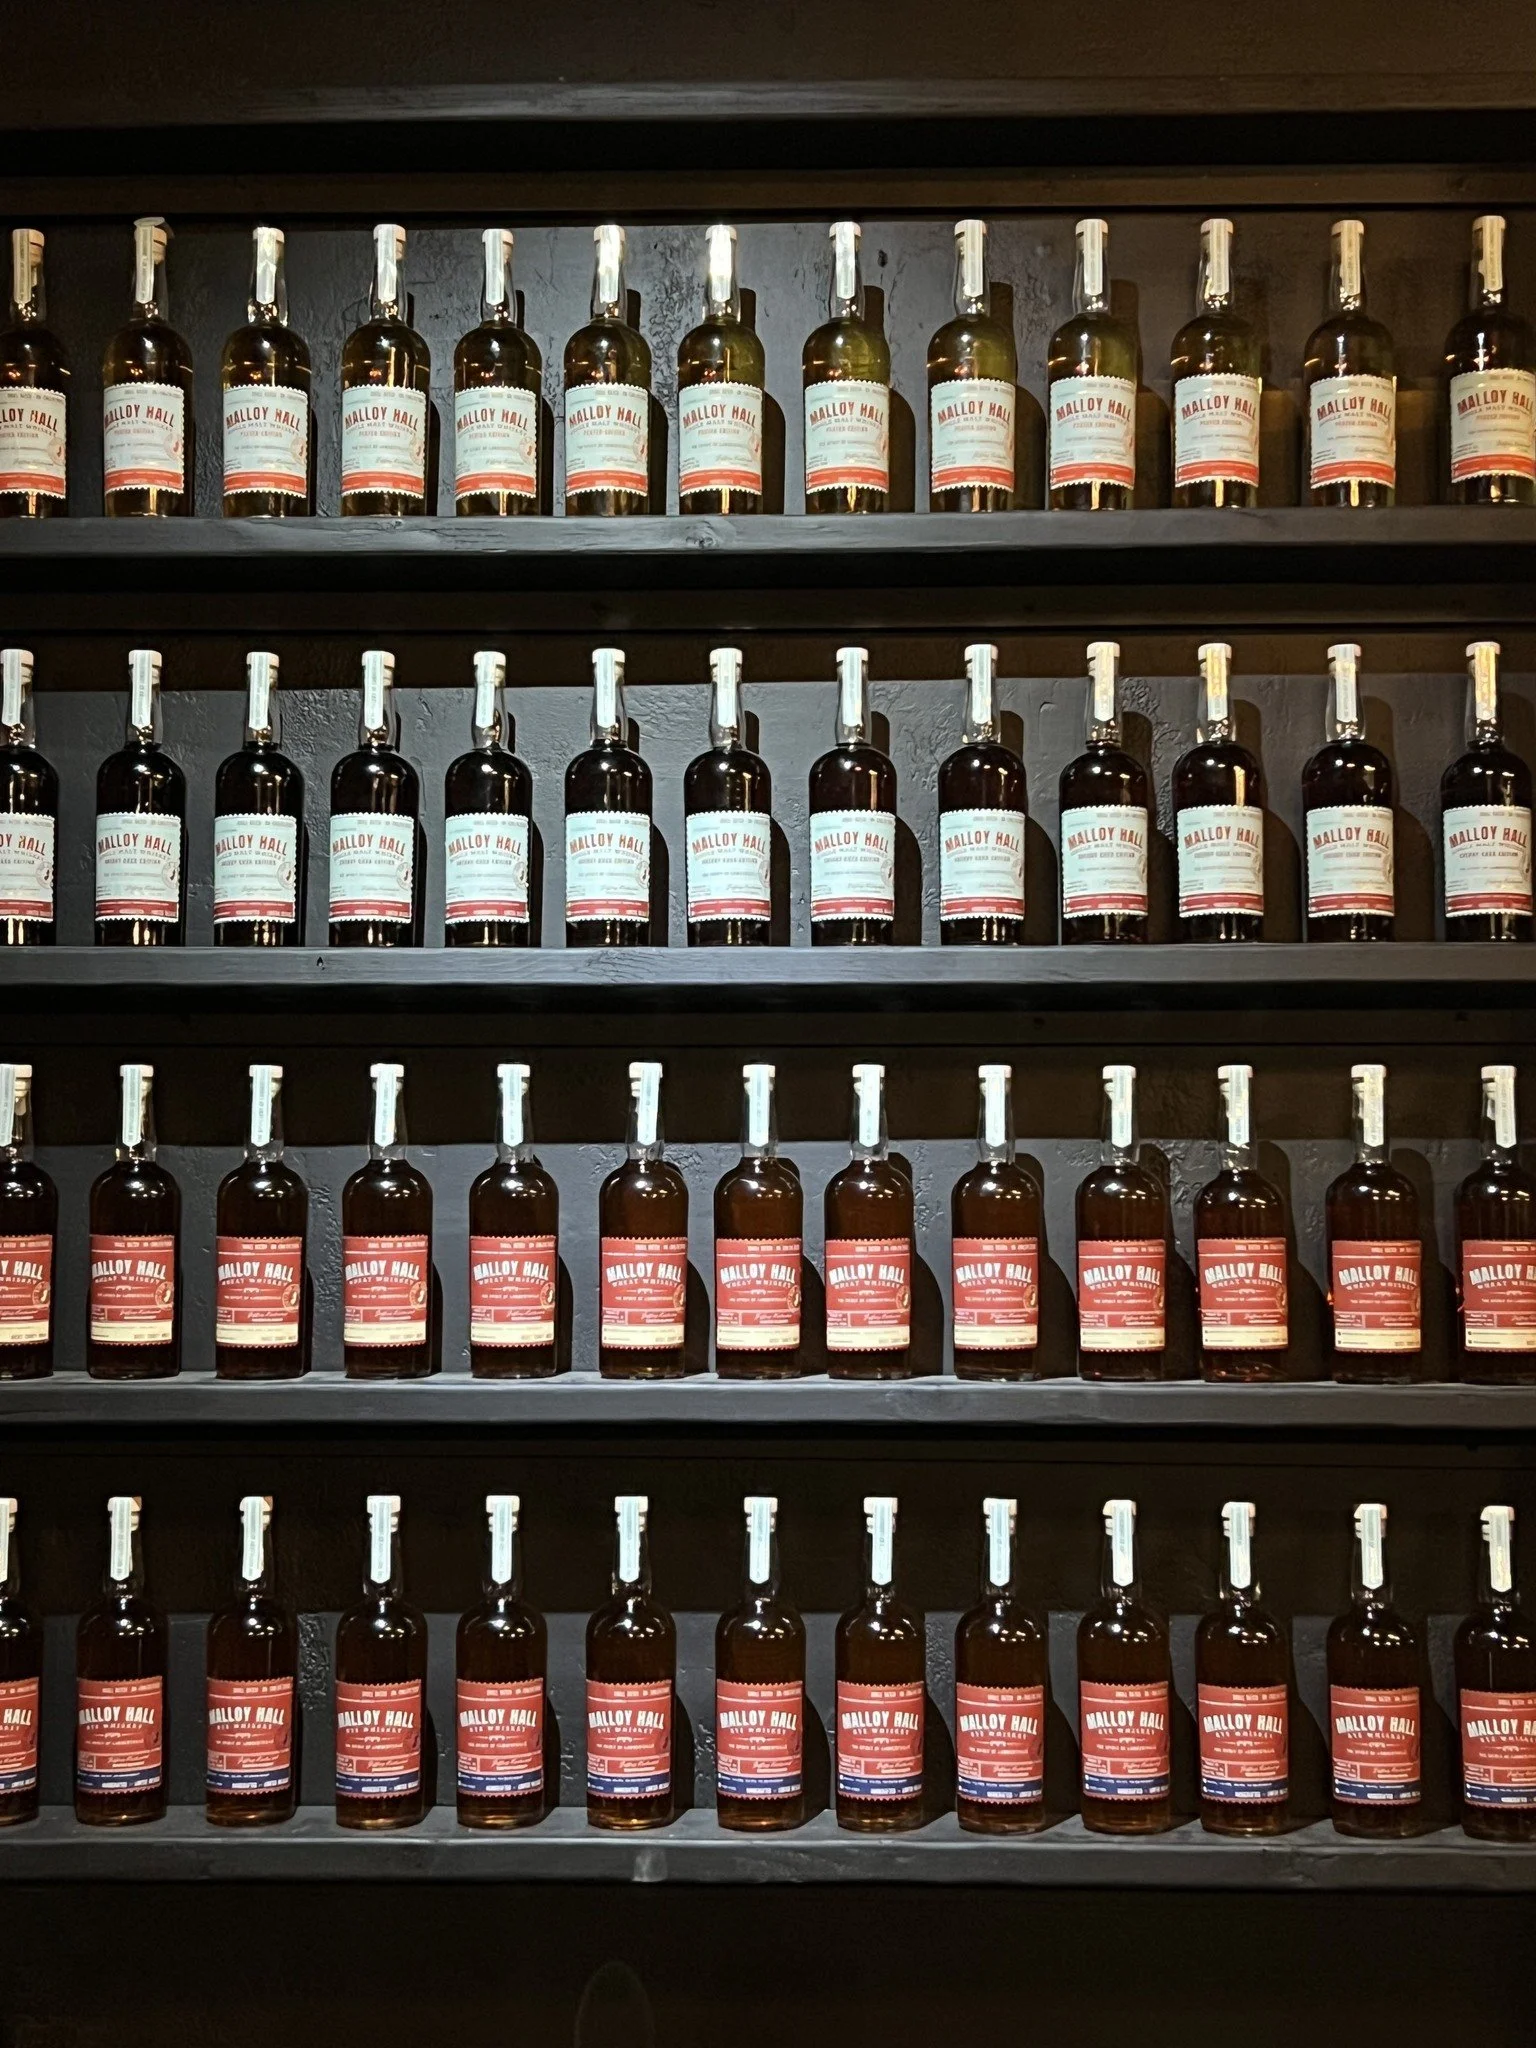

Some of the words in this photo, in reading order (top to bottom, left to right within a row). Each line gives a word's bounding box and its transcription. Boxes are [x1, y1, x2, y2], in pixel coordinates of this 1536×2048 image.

[938, 401, 983, 425] MALLOY
[989, 403, 1010, 424] HALL
[1056, 398, 1102, 421] MALLOY
[1108, 400, 1131, 421] HALL
[1182, 396, 1229, 420] MALLOY
[1235, 398, 1256, 420] HALL
[1317, 398, 1365, 421] MALLOY
[1371, 398, 1391, 419] HALL
[1458, 390, 1507, 415] MALLOY
[1513, 392, 1533, 414] HALL
[30, 410, 57, 432] HALL
[146, 406, 174, 427] HALL
[226, 407, 268, 429] MALLOY
[275, 410, 300, 431] HALL
[345, 407, 387, 428] MALLOY
[393, 409, 418, 431] HALL
[457, 408, 495, 431] MALLOY
[502, 409, 528, 430] HALL
[569, 405, 612, 428] MALLOY
[618, 407, 642, 428] HALL
[683, 404, 726, 428] MALLOY
[732, 406, 755, 428] HALL
[810, 402, 854, 426] MALLOY
[860, 403, 883, 425] HALL
[19, 836, 46, 855] HALL
[145, 835, 172, 854] HALL
[215, 835, 253, 856] MALLOY
[260, 836, 286, 856] HALL
[332, 834, 373, 855] MALLOY
[379, 836, 406, 856] HALL
[449, 835, 490, 856] MALLOY
[497, 836, 521, 856] HALL
[570, 833, 613, 855] MALLOY
[619, 836, 645, 855] HALL
[692, 833, 738, 854] MALLOY
[743, 835, 766, 854] HALL
[815, 832, 858, 854] MALLOY
[865, 833, 889, 853] HALL
[945, 831, 990, 853] MALLOY
[996, 833, 1019, 852] HALL
[1068, 827, 1114, 849] MALLOY
[1120, 829, 1143, 848] HALL
[1184, 826, 1231, 848] MALLOY
[1236, 828, 1260, 848] HALL
[1313, 827, 1361, 848] MALLOY
[1367, 829, 1389, 849] HALL
[1449, 826, 1497, 848] MALLOY
[1503, 828, 1527, 848] HALL
[14, 1261, 43, 1280] HALL
[137, 1260, 166, 1279] HALL
[218, 1262, 260, 1282] MALLOY
[265, 1263, 294, 1282] HALL
[345, 1260, 386, 1281] MALLOY
[391, 1261, 419, 1280] HALL
[474, 1260, 518, 1281] MALLOY
[523, 1261, 548, 1280] HALL
[606, 1263, 653, 1283] MALLOY
[658, 1263, 681, 1282] HALL
[720, 1264, 766, 1284] MALLOY
[771, 1264, 795, 1283] HALL
[829, 1264, 873, 1284] MALLOY
[879, 1265, 904, 1283] HALL
[956, 1263, 1001, 1283] MALLOY
[1006, 1264, 1032, 1283] HALL
[1084, 1265, 1132, 1286] MALLOY
[1136, 1266, 1160, 1285] HALL
[1205, 1263, 1254, 1284] MALLOY
[1259, 1264, 1282, 1282] HALL
[1339, 1265, 1390, 1285] MALLOY
[1395, 1266, 1417, 1285] HALL
[1470, 1264, 1522, 1285] MALLOY
[4, 1709, 31, 1725] HALL
[126, 1707, 154, 1724] HALL
[209, 1707, 251, 1725] MALLOY
[256, 1707, 285, 1725] HALL
[338, 1710, 380, 1727] MALLOY
[386, 1711, 413, 1728] HALL
[460, 1709, 505, 1727] MALLOY
[510, 1709, 536, 1727] HALL
[588, 1710, 632, 1728] MALLOY
[637, 1711, 664, 1729] HALL
[720, 1710, 766, 1728] MALLOY
[771, 1711, 797, 1730] HALL
[842, 1711, 889, 1730] MALLOY
[894, 1712, 918, 1730] HALL
[960, 1714, 1007, 1732] MALLOY
[1012, 1715, 1037, 1735] HALL
[1086, 1711, 1134, 1729] MALLOY
[1140, 1712, 1164, 1730] HALL
[1204, 1714, 1252, 1733] MALLOY
[1258, 1715, 1282, 1734] HALL
[1336, 1715, 1384, 1733] MALLOY
[1390, 1717, 1414, 1735] HALL
[1467, 1719, 1518, 1738] MALLOY
